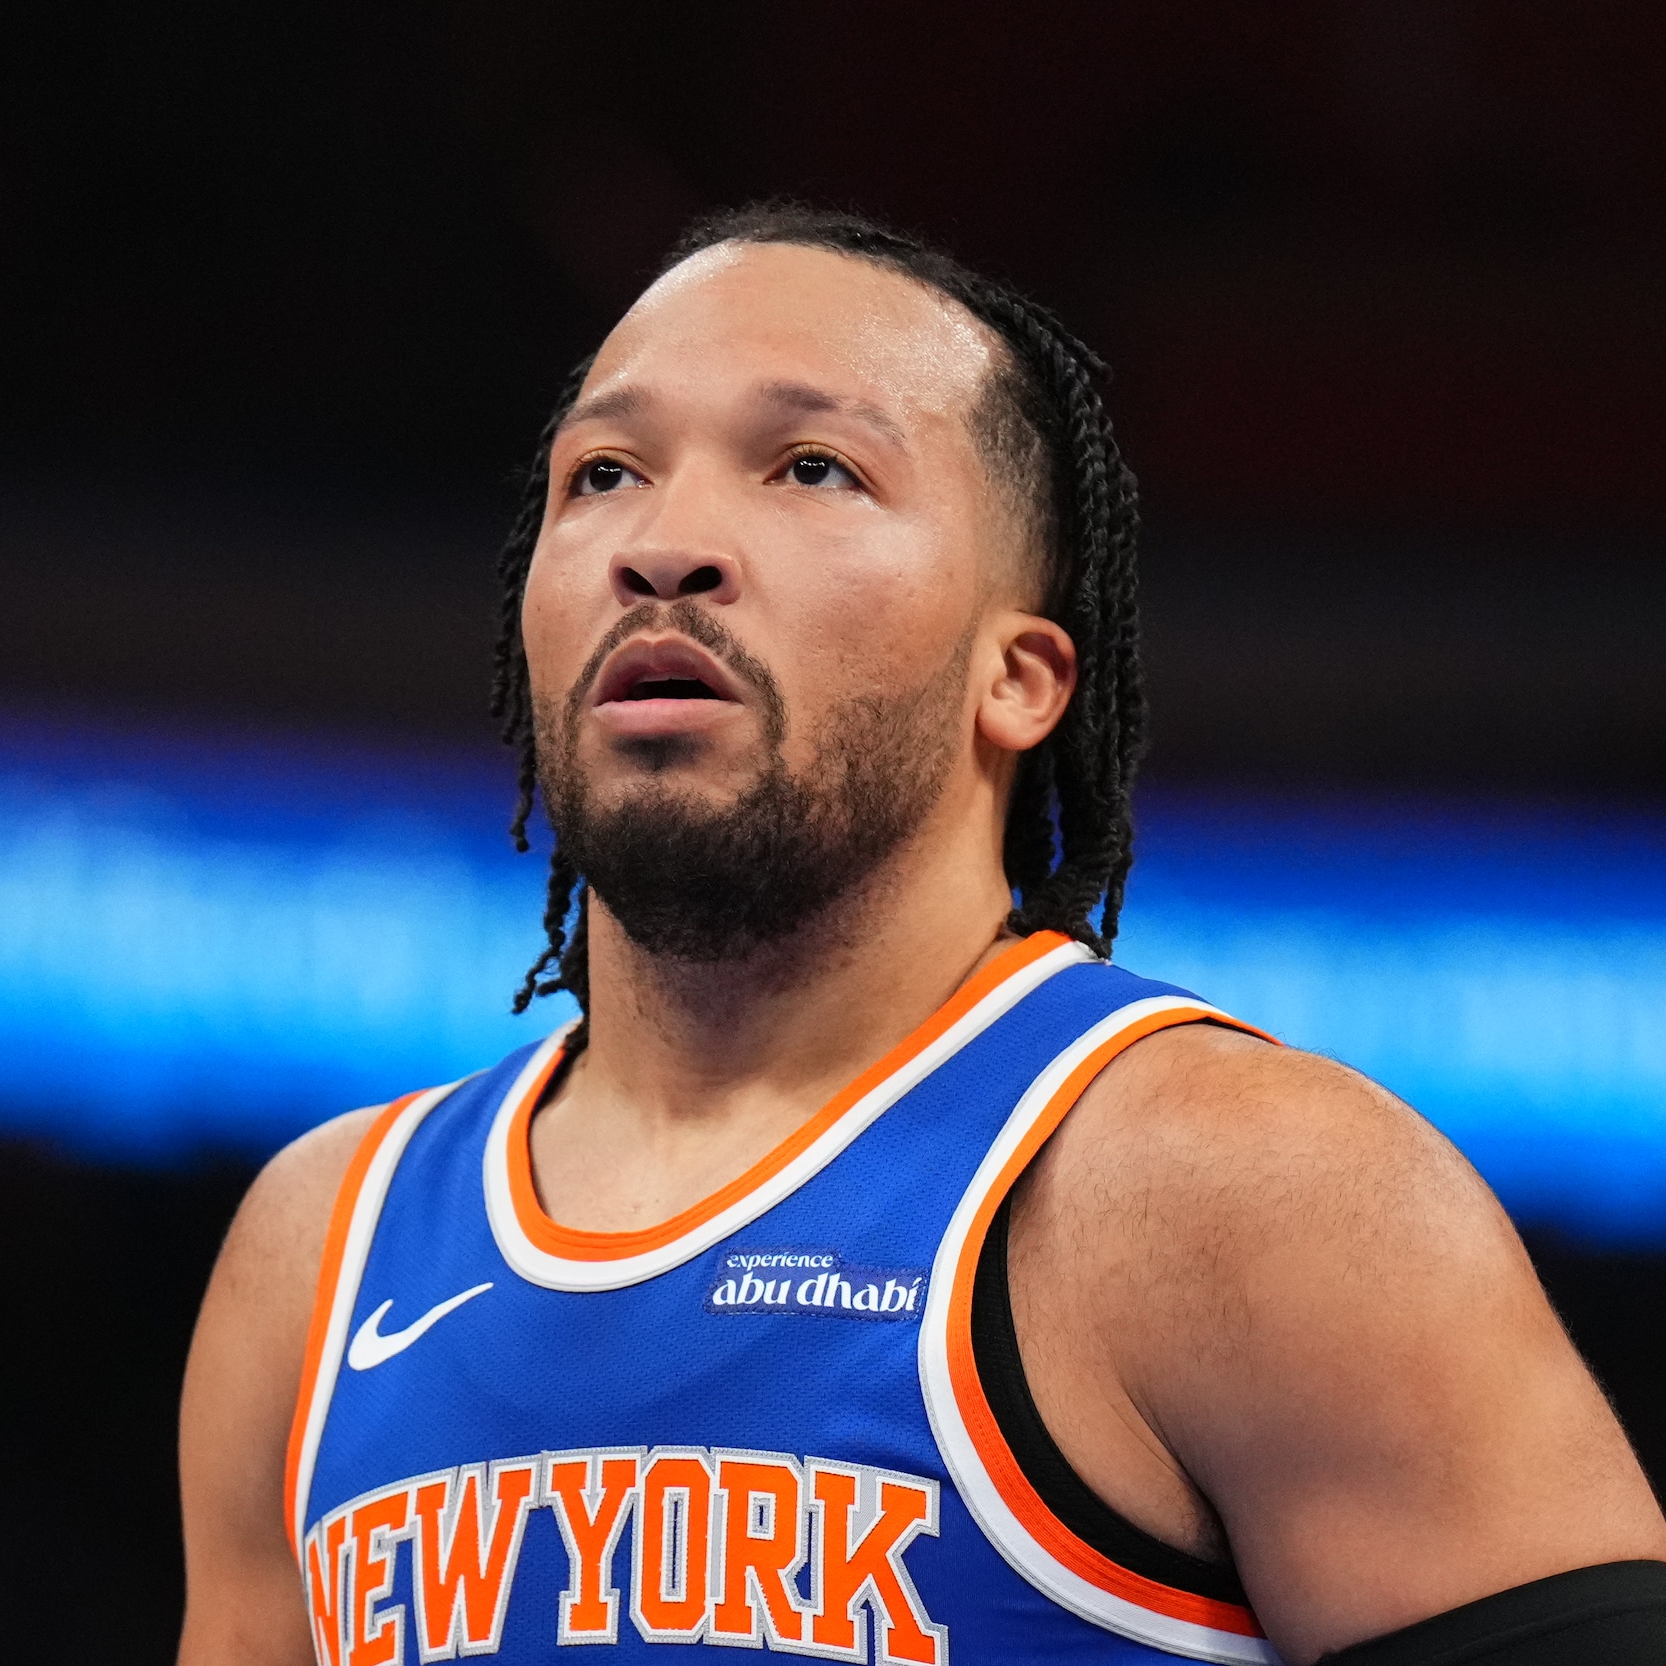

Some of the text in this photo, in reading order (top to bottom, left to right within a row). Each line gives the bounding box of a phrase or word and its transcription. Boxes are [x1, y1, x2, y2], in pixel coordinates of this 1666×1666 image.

[726, 1251, 834, 1272] experience
[712, 1270, 923, 1313] abu dhabi
